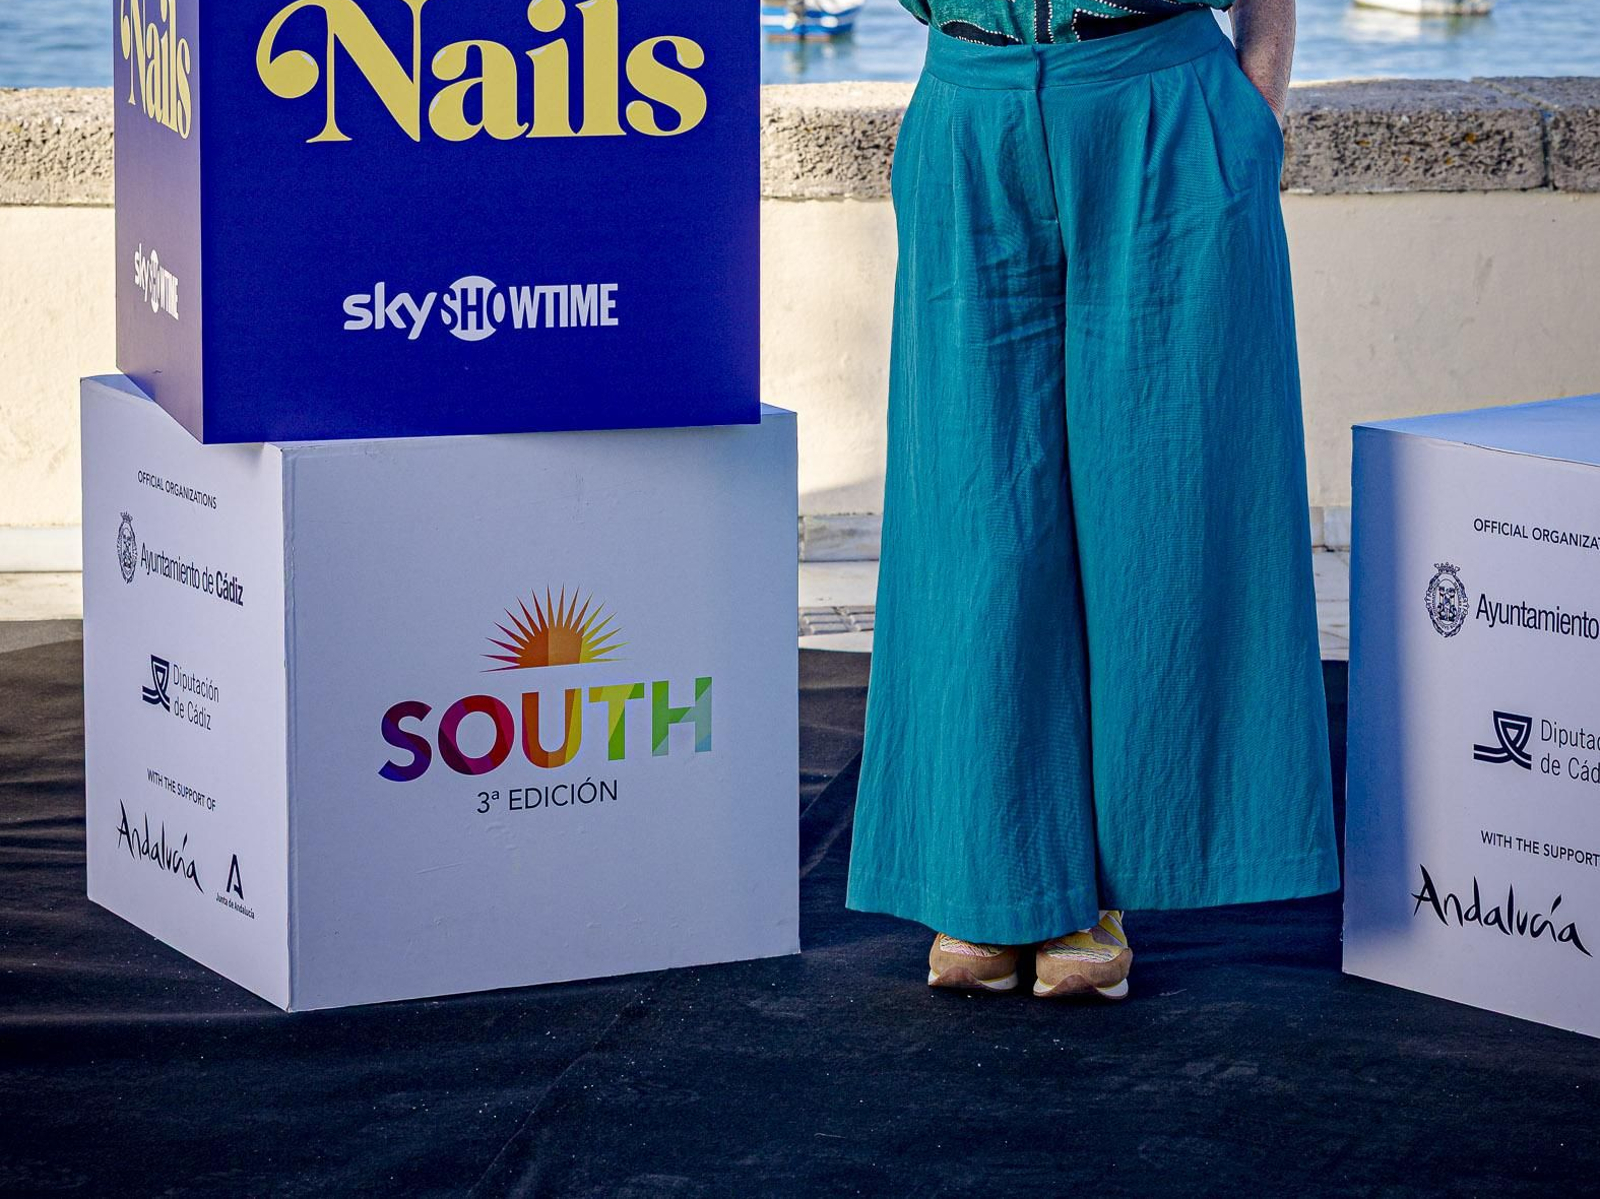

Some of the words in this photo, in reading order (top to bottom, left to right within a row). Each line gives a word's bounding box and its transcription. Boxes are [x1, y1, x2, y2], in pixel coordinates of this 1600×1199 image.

[137, 470, 164, 491] OFFICIAL
[165, 480, 217, 509] ORGANIZATIONS
[1473, 518, 1529, 539] OFFICIAL
[140, 542, 200, 590] Ayuntamiento
[202, 566, 214, 595] de
[215, 570, 244, 606] Cádiz
[1475, 593, 1600, 640] Ayuntamiento
[173, 664, 220, 703] Diputación
[174, 696, 185, 719] de
[187, 700, 211, 731] Cádiz
[377, 676, 713, 783] SOUTH
[1540, 752, 1561, 777] de
[147, 768, 164, 786] WITH
[164, 776, 176, 794] THE
[177, 783, 206, 807] SUPPORT
[206, 797, 216, 812] OF
[508, 776, 618, 811] EDICIÓN
[116, 798, 205, 894] Andalucía
[1480, 830, 1513, 850] WITH
[1515, 837, 1540, 855] THE
[1543, 843, 1600, 867] SUPPORT
[228, 898, 234, 909] de
[1410, 863, 1593, 958] Andalucía
